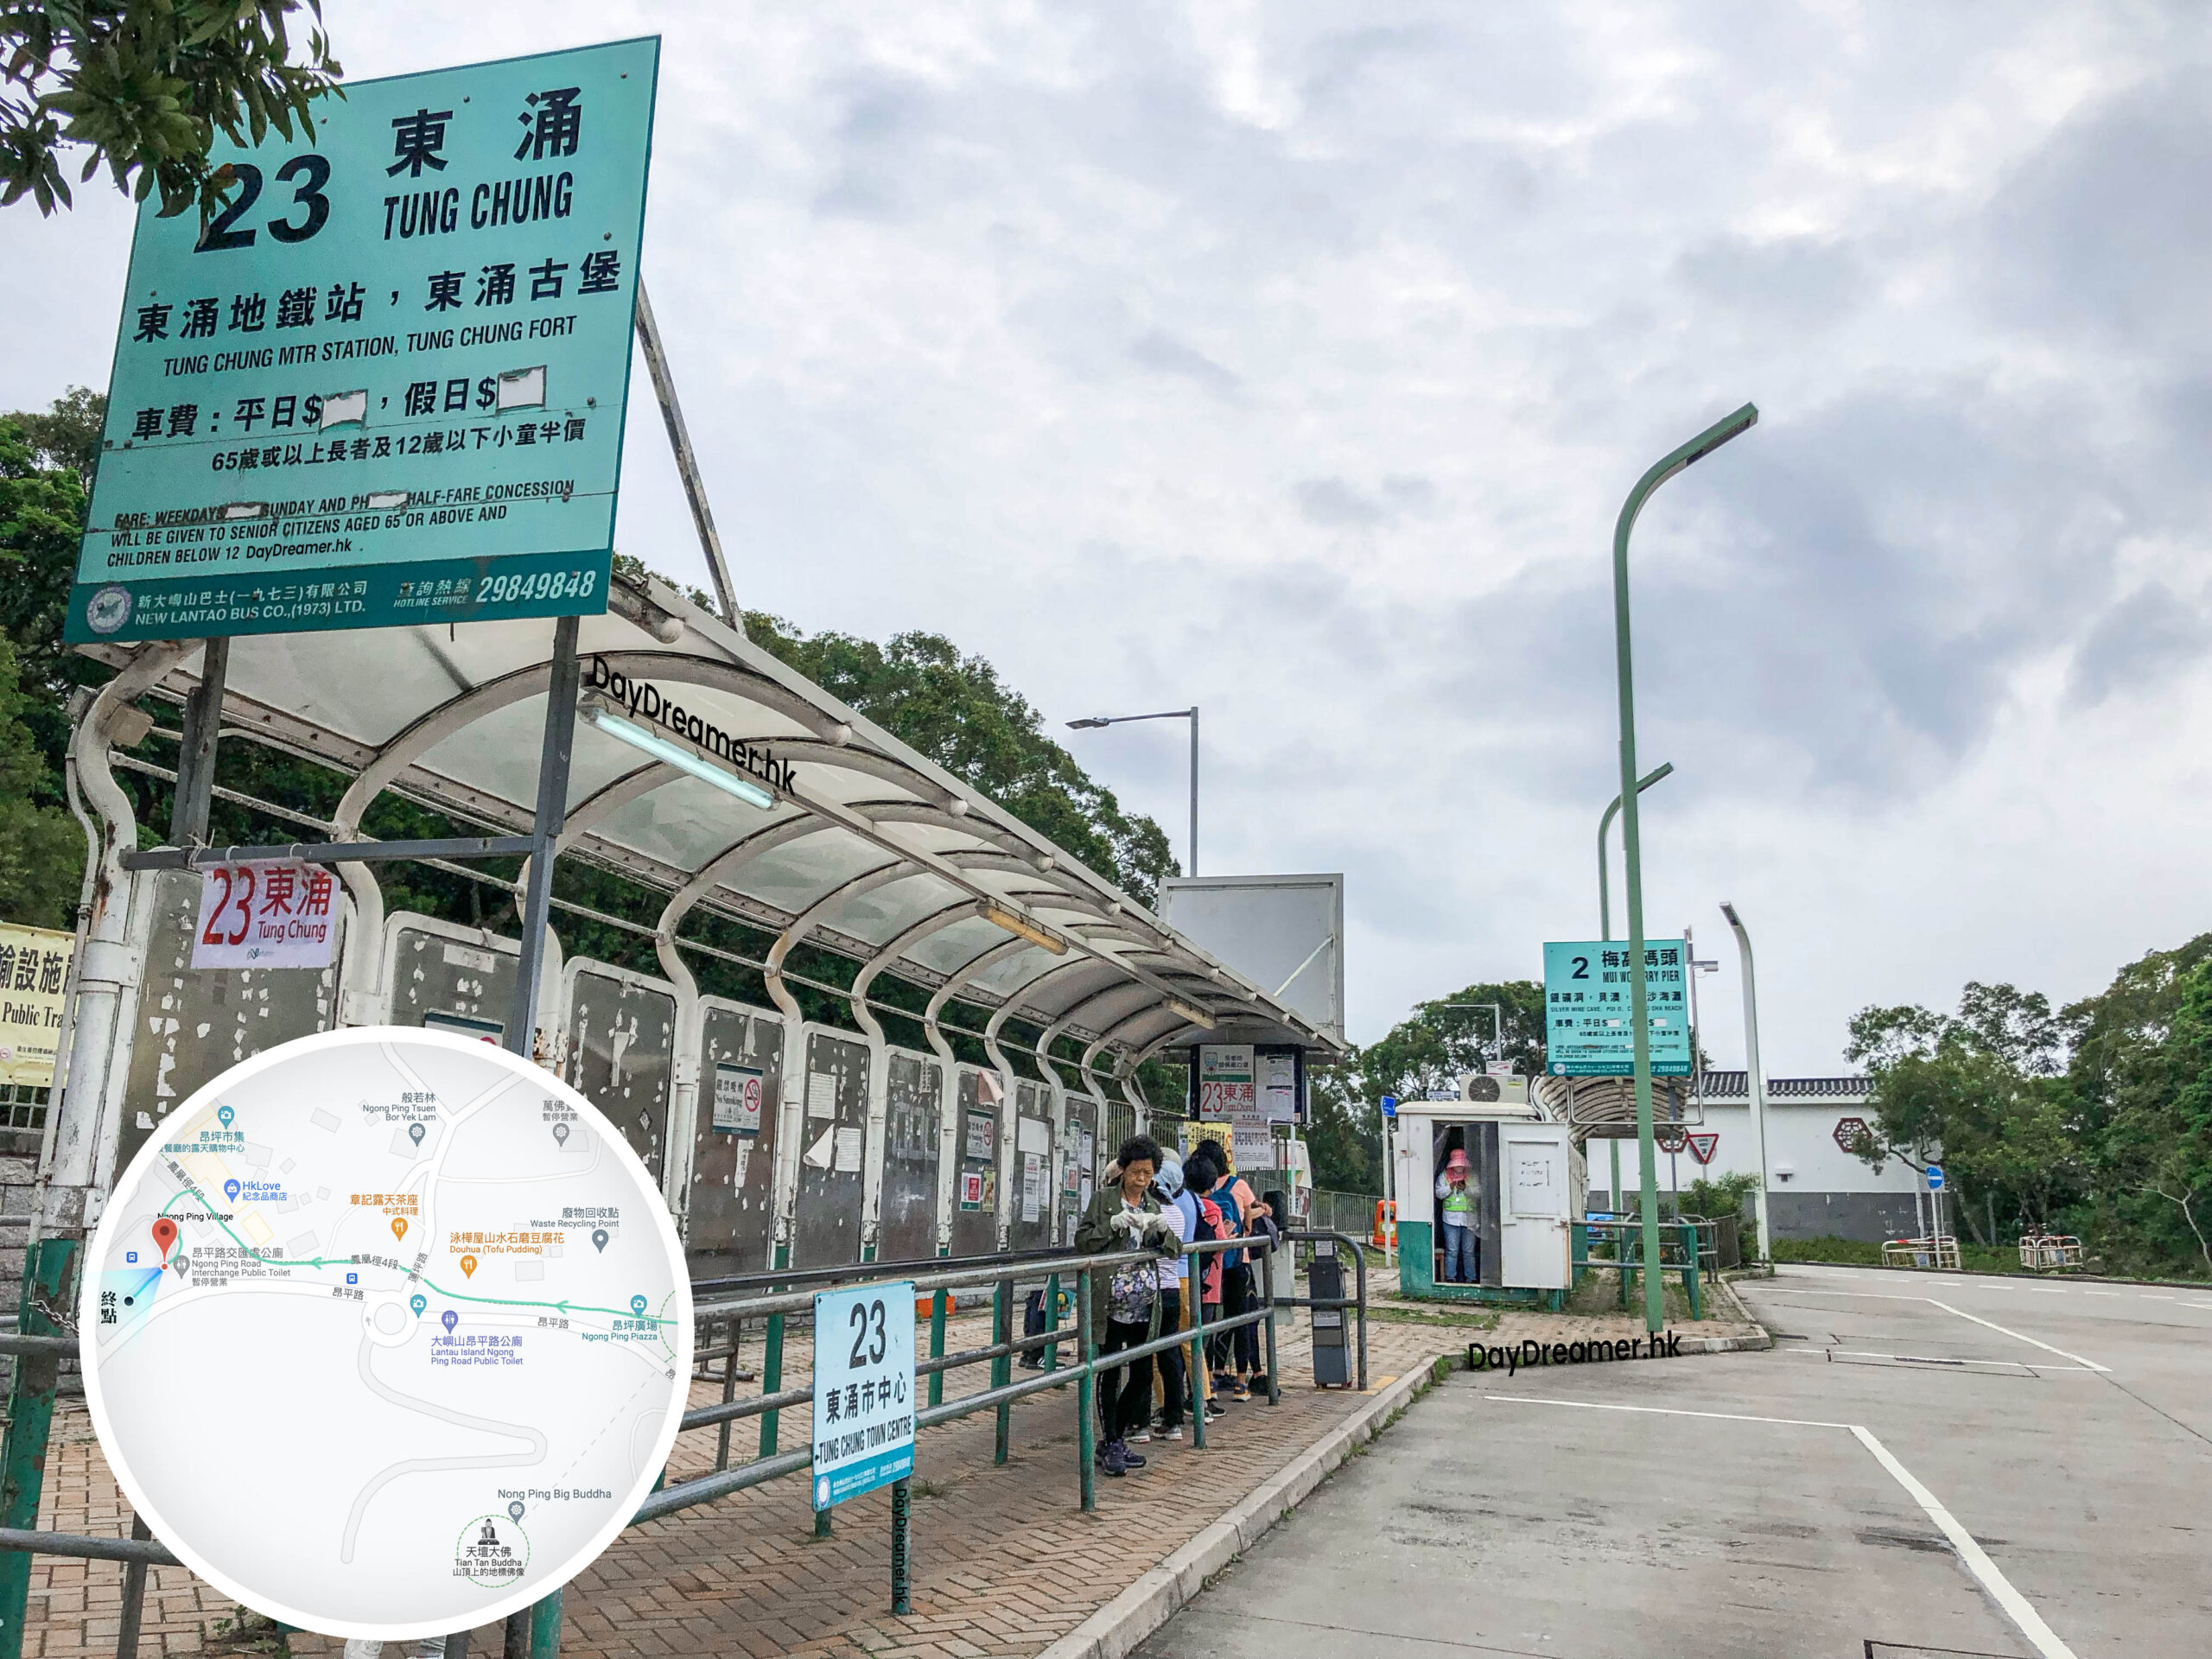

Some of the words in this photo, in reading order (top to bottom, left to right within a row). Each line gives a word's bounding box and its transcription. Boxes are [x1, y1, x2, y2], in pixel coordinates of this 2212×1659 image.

[385, 87, 582, 178] 東涌
[192, 153, 331, 254] 23
[384, 188, 458, 241] TUNG
[469, 171, 573, 231] CHUNG
[164, 355, 208, 377] TUNG
[213, 347, 273, 372] CHUNG
[278, 343, 317, 366] MTR
[321, 335, 398, 361] STATION,
[407, 328, 454, 353] TUNG
[460, 321, 523, 346] CHUNG
[529, 315, 577, 339] FORT
[212, 418, 586, 472] 65歲或以上長者及12歲以下小童半價
[115, 512, 150, 529] FARE:
[263, 499, 315, 518] SUNDAY
[319, 496, 346, 513] AND
[351, 493, 370, 510] PH
[406, 486, 481, 505] HALF-FARE
[486, 479, 575, 500] CONCESSION
[111, 530, 141, 548] WILL
[146, 529, 162, 545] BE
[166, 527, 204, 544] GIVEN
[209, 525, 226, 542] TO
[230, 521, 278, 540] SENIOR
[282, 517, 340, 537] CITIZENS
[344, 515, 380, 533] AGED
[385, 514, 401, 530] 65
[405, 512, 424, 527] OR
[429, 507, 475, 525] ABOVE
[478, 505, 508, 521] AND
[107, 550, 171, 568] CHILDREN
[175, 547, 221, 564] BELOW
[225, 545, 241, 561] 12
[393, 596, 430, 608] HOTLINE
[431, 594, 470, 607] SERVICE
[475, 570, 596, 603] 29849848
[135, 612, 167, 626] NEW
[170, 607, 226, 624] LANTAO
[230, 607, 259, 620] BUS
[334, 600, 366, 614] LTD.
[202, 866, 256, 946] 23
[259, 866, 333, 917] 東涌
[258, 920, 285, 944] Tung
[288, 919, 327, 944] Chung
[1571, 957, 1589, 980] 2
[1602, 971, 1618, 983] MUI
[1662, 969, 1680, 982] PIER
[2, 1001, 41, 1027] Public
[715, 1093, 723, 1104] No
[722, 1094, 744, 1109] Smoking
[1202, 1082, 1224, 1113] 23
[1223, 1083, 1253, 1102] 東涌
[849, 1299, 887, 1370] 23
[826, 1371, 906, 1425] 東涌市中心
[819, 1438, 839, 1465] TUNG
[841, 1429, 865, 1458] CHUNG
[866, 1423, 886, 1449] TOWN
[887, 1414, 912, 1442] CENTRE
